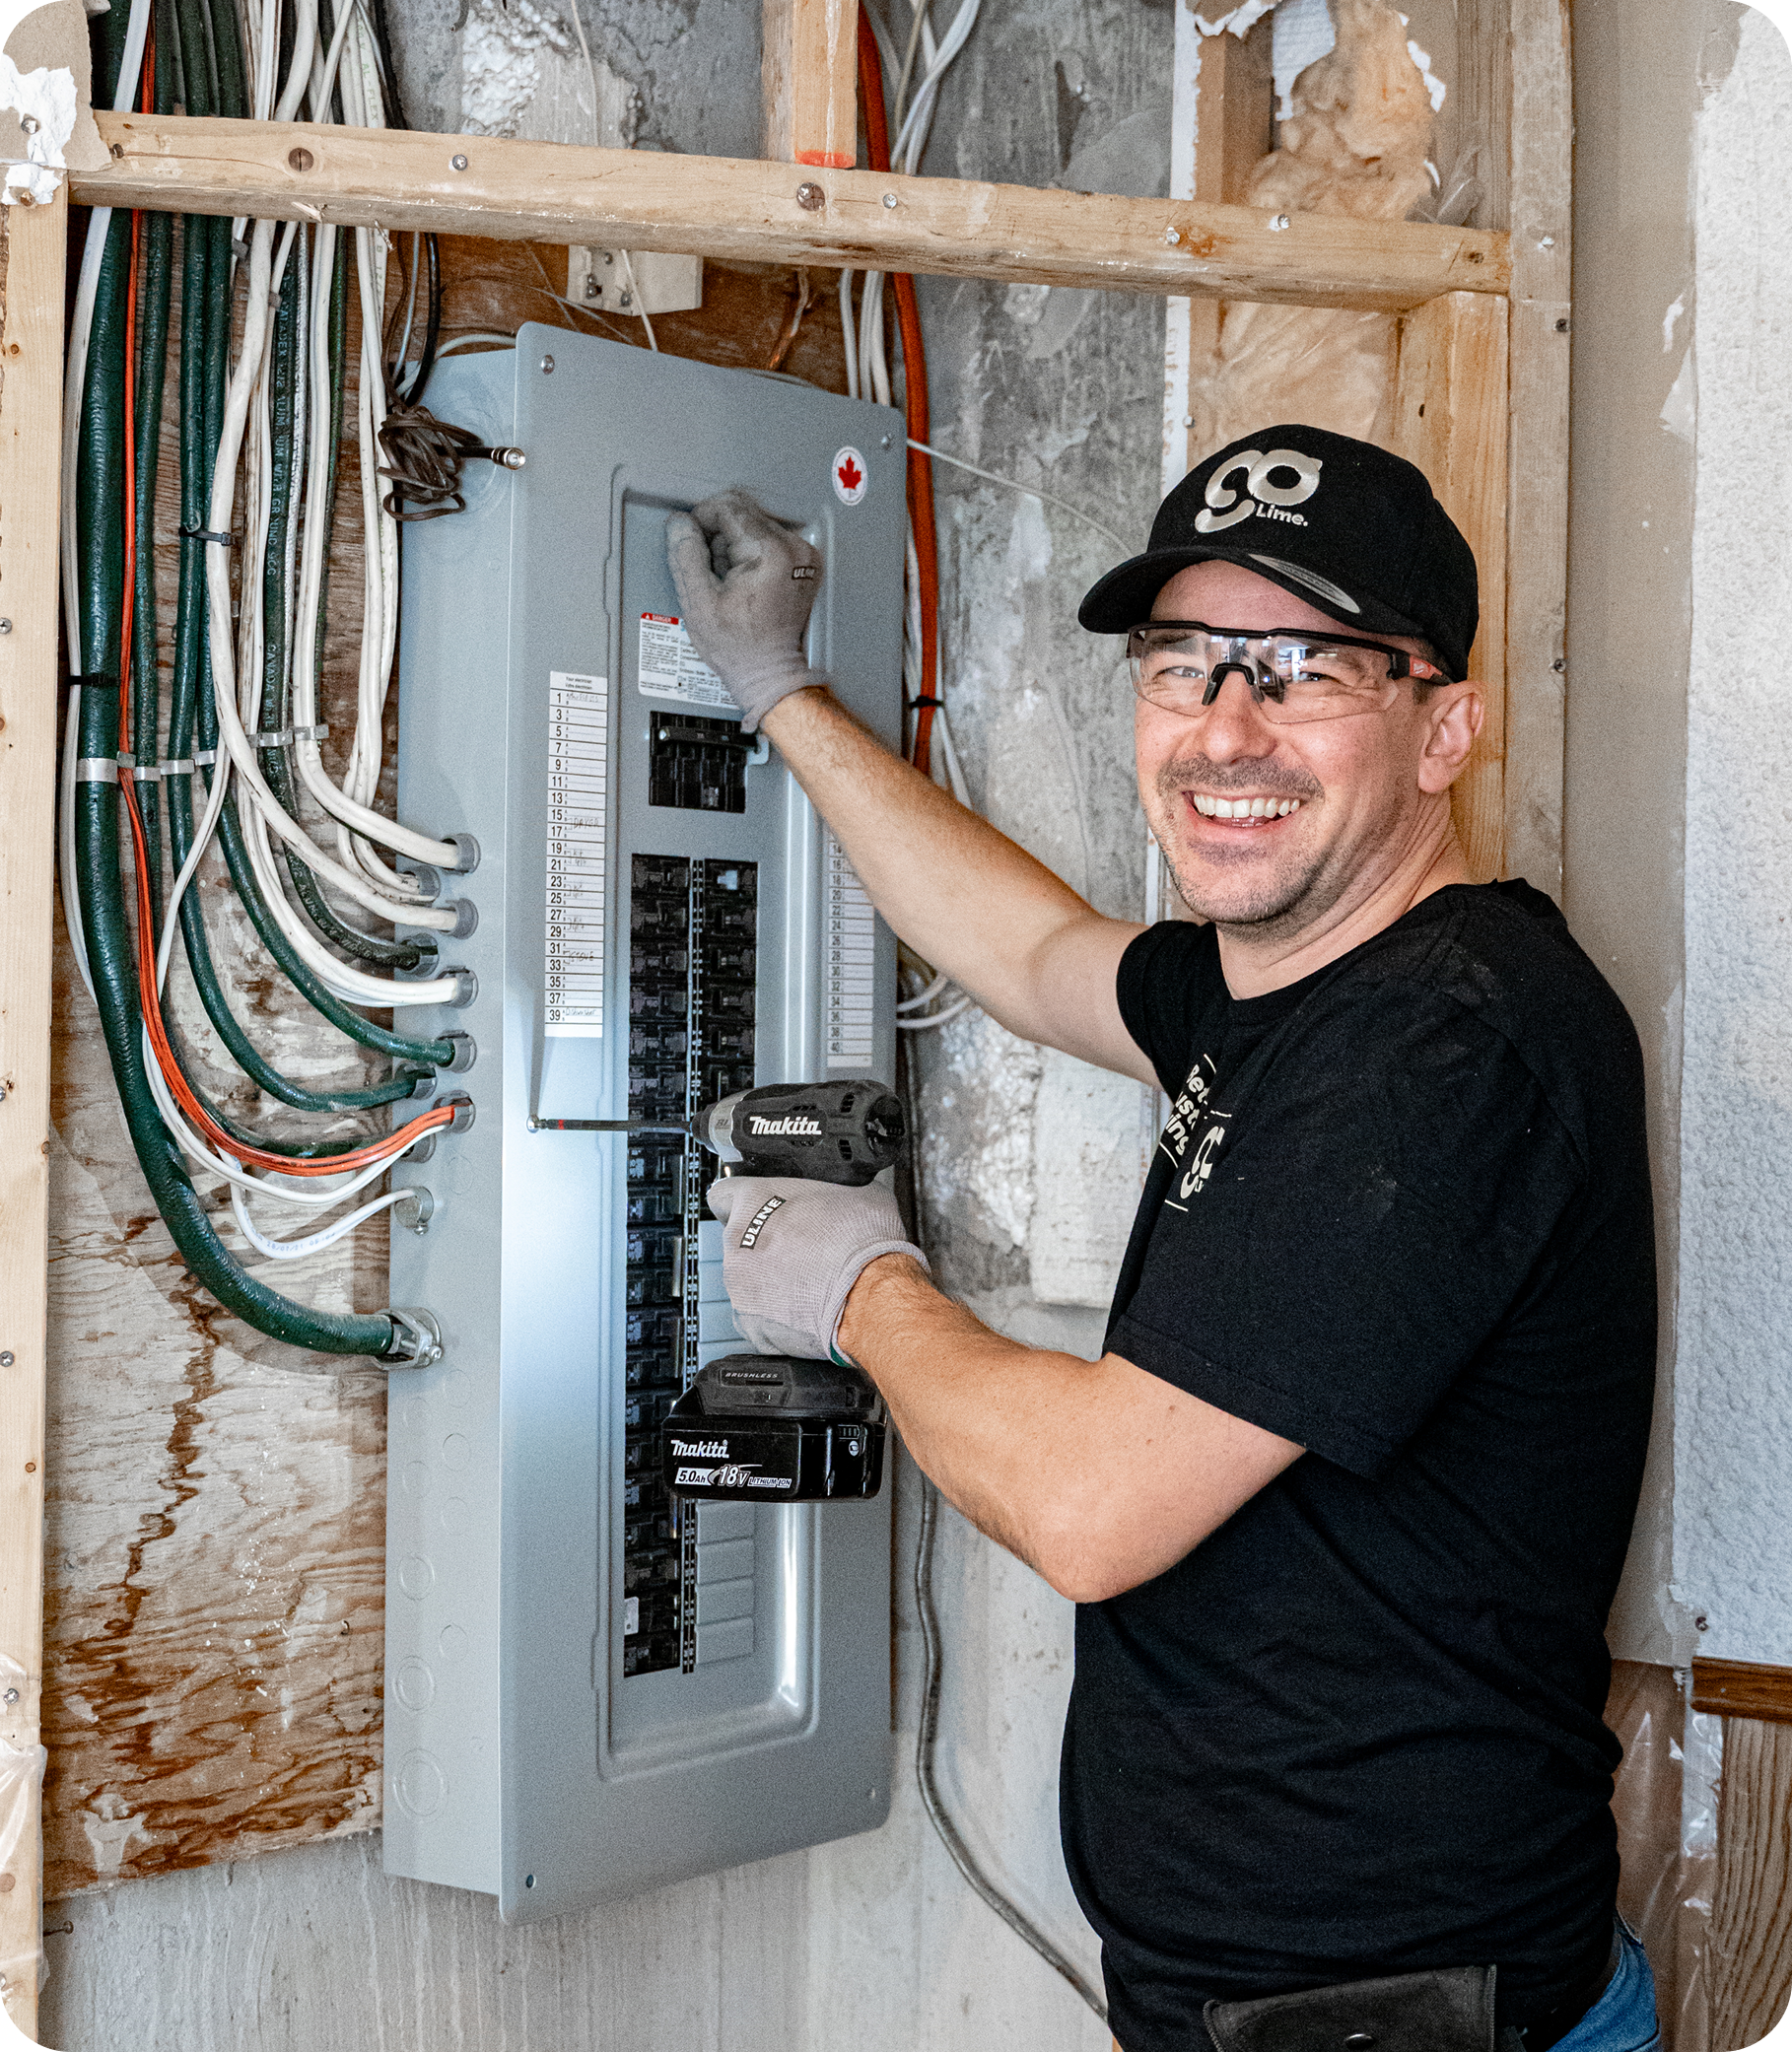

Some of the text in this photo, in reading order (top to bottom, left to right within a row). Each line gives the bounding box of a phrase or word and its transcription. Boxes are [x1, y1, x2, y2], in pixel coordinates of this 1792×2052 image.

[361, 63, 379, 120] AL-FLEX
[1255, 503, 1309, 527] Lime.
[557, 693, 561, 704] 1
[556, 709, 562, 720] 3
[556, 725, 562, 737] 5
[556, 742, 562, 754] 7
[555, 759, 561, 771] 9
[552, 776, 562, 787] 11
[552, 792, 562, 803] 13
[552, 809, 562, 820] 15
[552, 826, 562, 837] 17
[552, 843, 562, 854] 19
[551, 858, 561, 870] 21
[551, 875, 562, 887] 23
[551, 892, 562, 904] 25
[551, 909, 562, 921] 27
[551, 925, 561, 937] 29
[550, 942, 560, 954] 31
[550, 959, 561, 971] 33
[550, 976, 561, 988] 35
[550, 992, 560, 1003] 37
[550, 1009, 560, 1020] 39
[749, 1116, 822, 1135] Makita
[741, 1197, 783, 1248] ULINE
[678, 1470, 707, 1483] 5.0Ah
[719, 1465, 749, 1486] 18V
